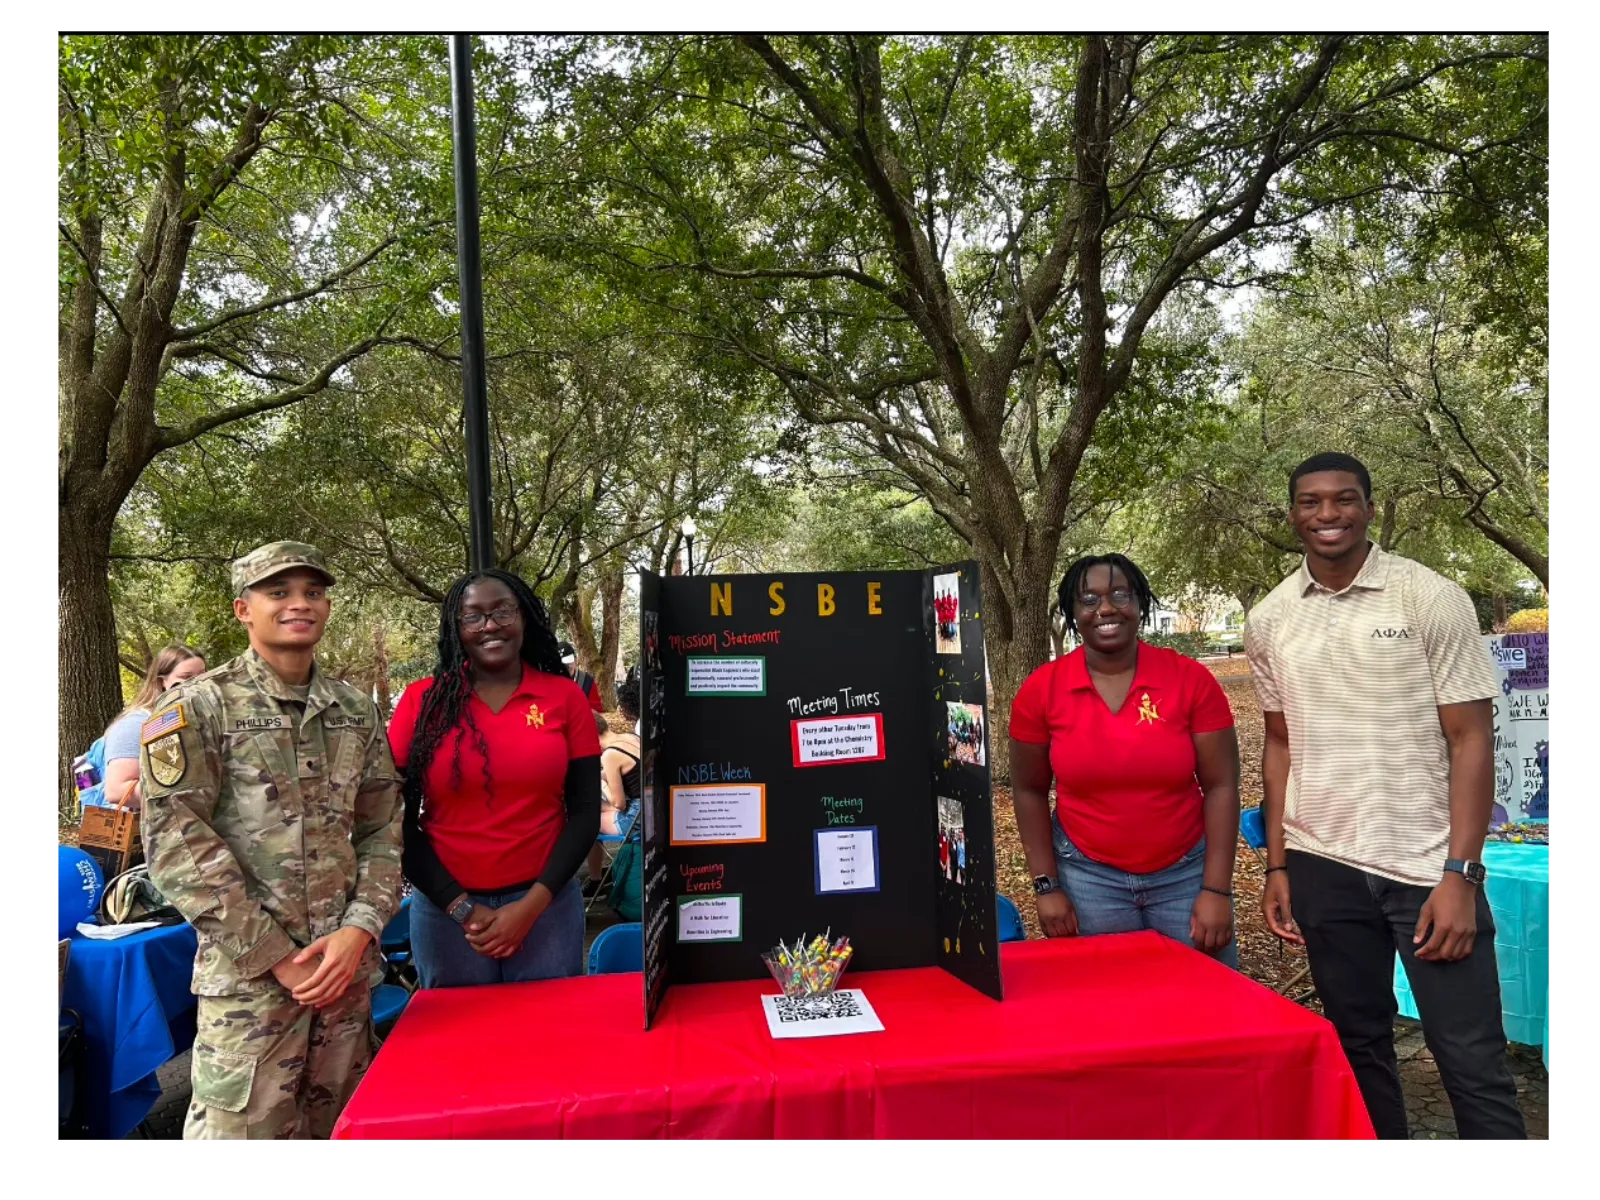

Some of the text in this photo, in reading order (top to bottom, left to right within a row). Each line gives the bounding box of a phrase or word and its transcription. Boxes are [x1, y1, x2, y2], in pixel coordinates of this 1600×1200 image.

[669, 630, 780, 655] Mission Statement
[787, 686, 880, 716] Meeting Times
[236, 717, 282, 730] PHILLIPS
[802, 727, 818, 736] Every
[844, 735, 873, 744] Chemistry
[678, 761, 752, 784] NSBE Week
[820, 796, 863, 813] Meeting
[825, 810, 855, 825] Dates
[680, 863, 724, 879] Upcoming
[687, 878, 722, 892] Events
